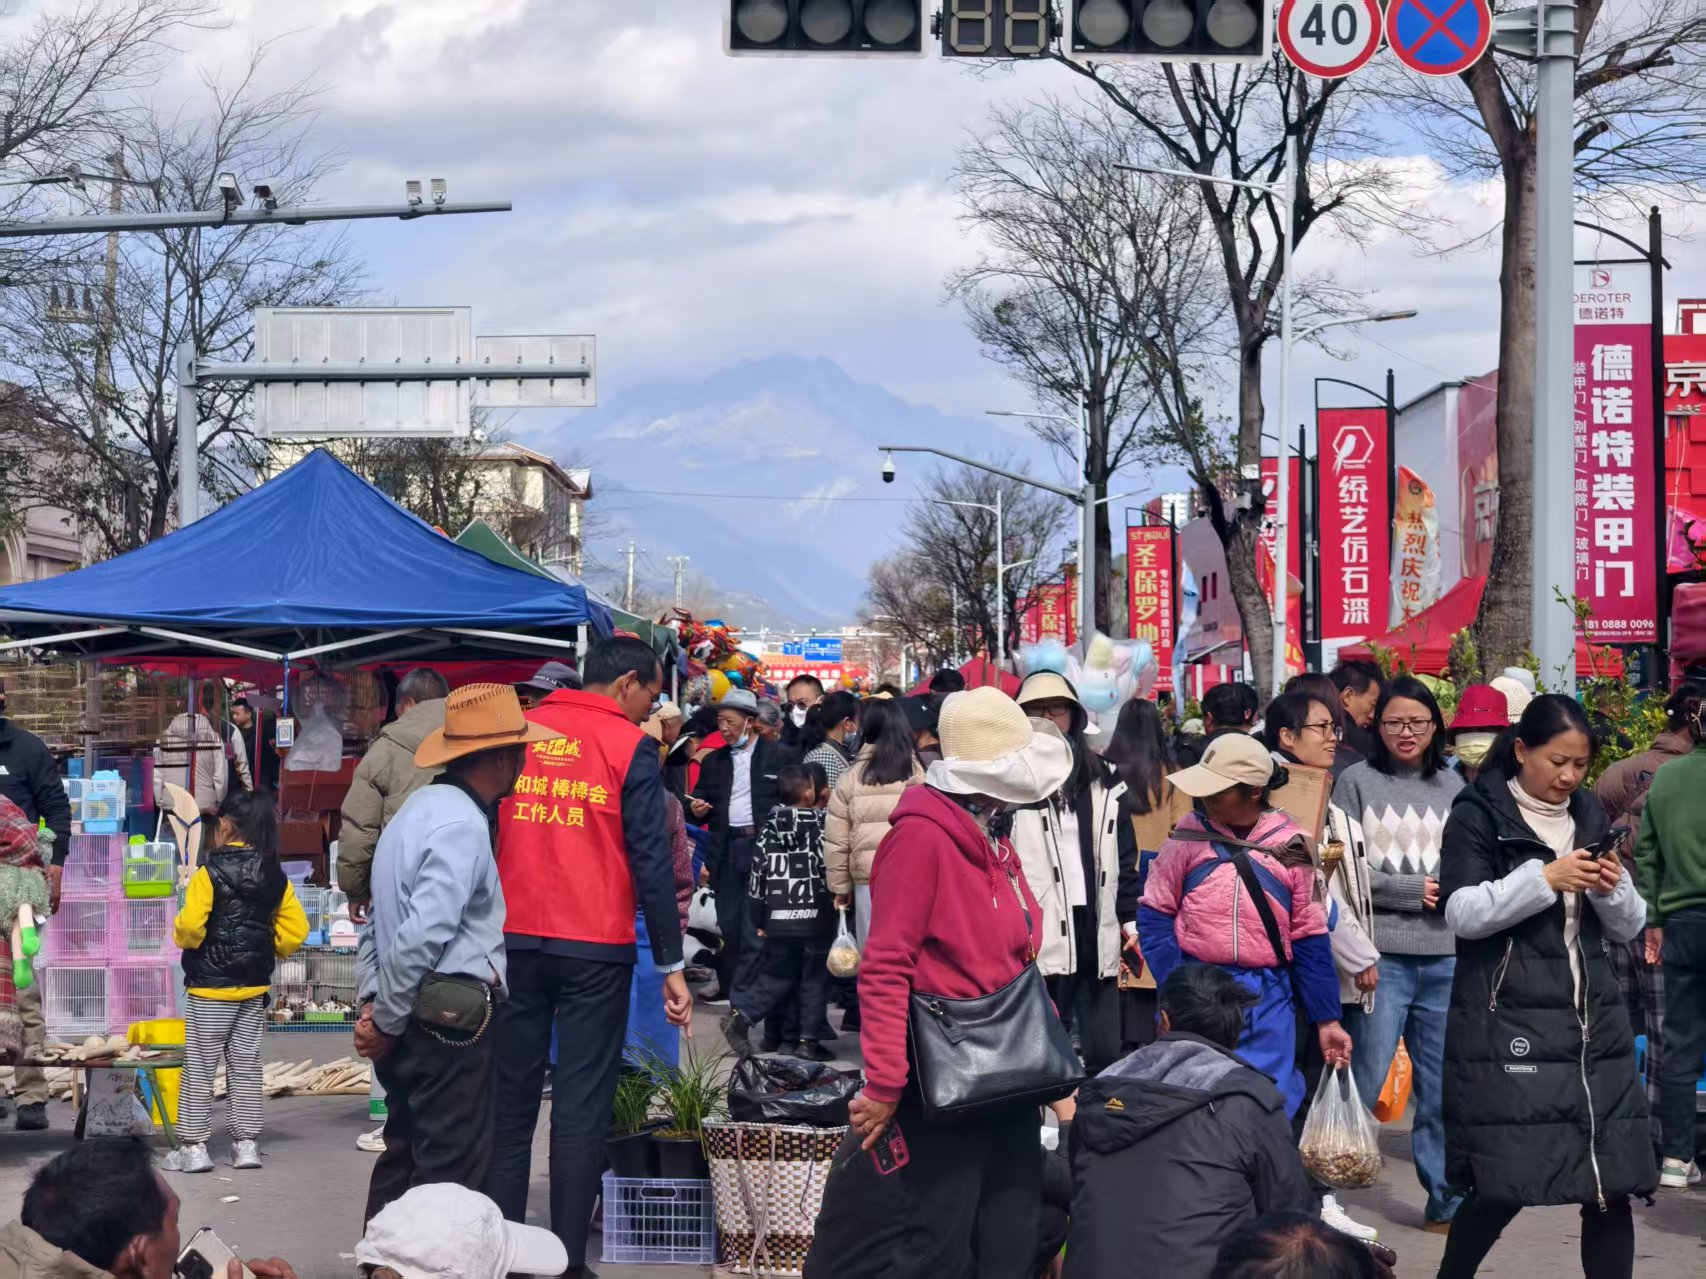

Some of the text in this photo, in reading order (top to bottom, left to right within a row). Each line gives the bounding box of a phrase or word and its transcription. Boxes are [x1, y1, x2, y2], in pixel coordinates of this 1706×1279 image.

[1300, 3, 1357, 45] 40
[1579, 307, 1625, 320] 德诺特
[1591, 344, 1635, 597] 德诺特装甲门
[1338, 475, 1370, 624] 统艺仿石漆
[1602, 620, 1627, 629] 0888
[1630, 619, 1654, 629] 0096
[552, 777, 608, 805] 棒棒会
[512, 802, 585, 828] 工作人员
